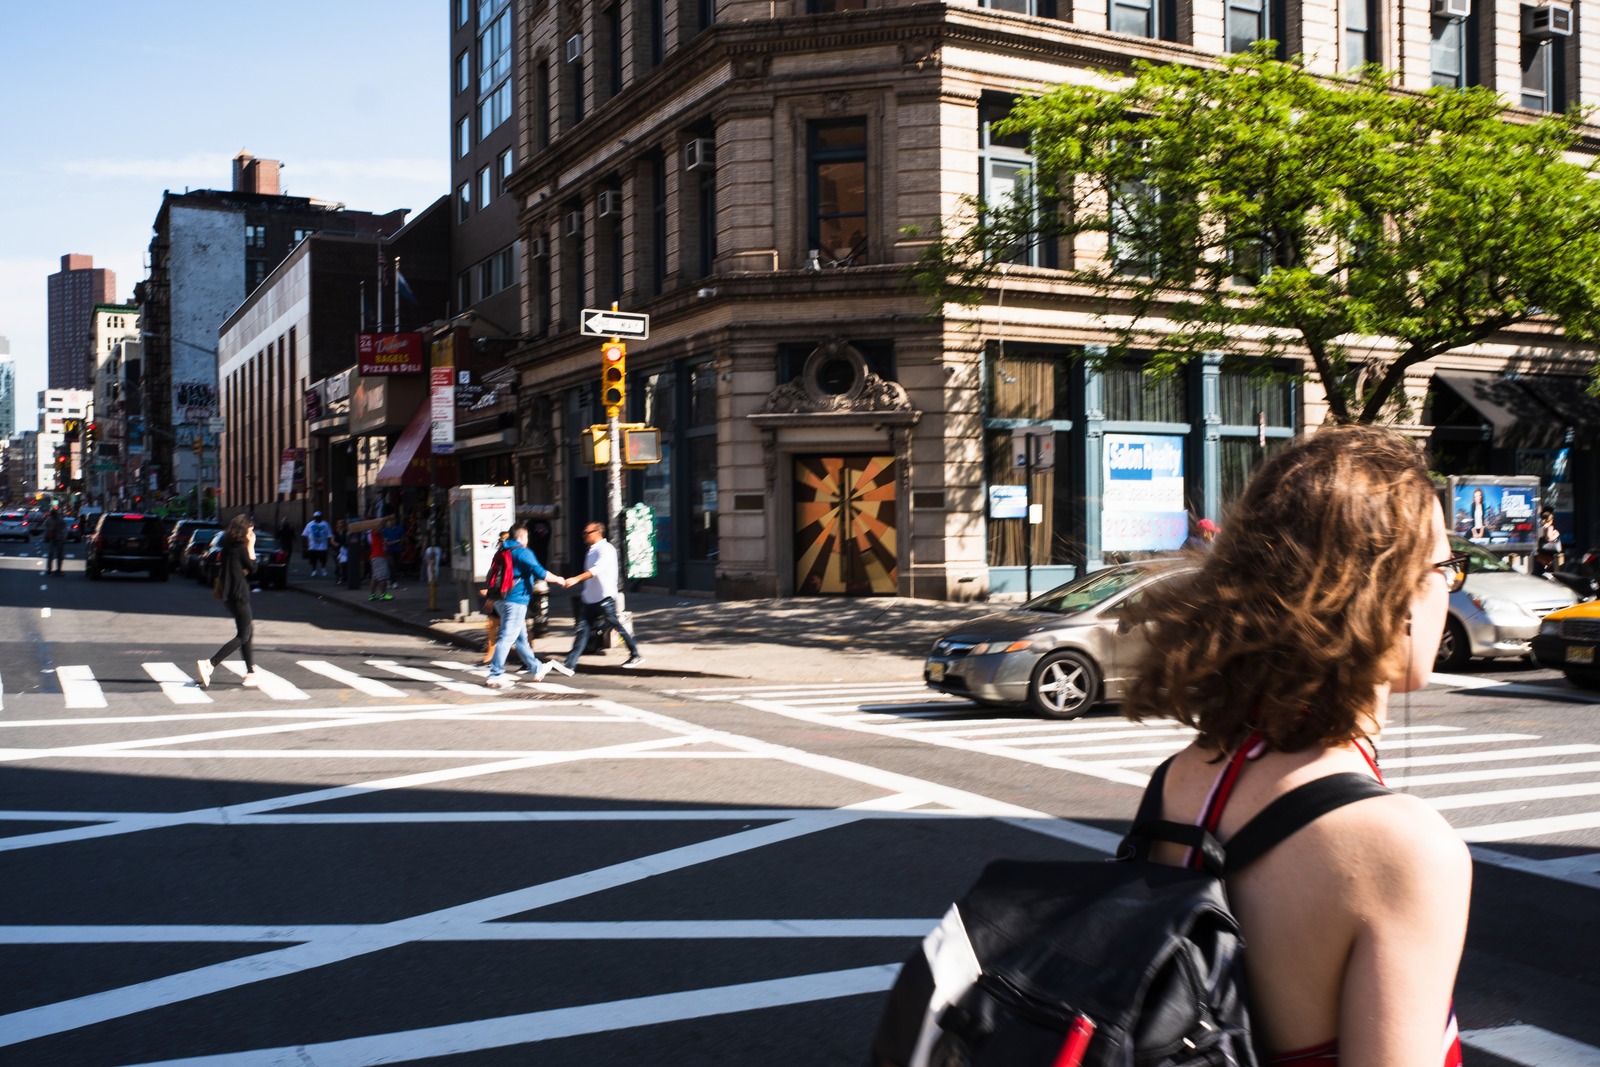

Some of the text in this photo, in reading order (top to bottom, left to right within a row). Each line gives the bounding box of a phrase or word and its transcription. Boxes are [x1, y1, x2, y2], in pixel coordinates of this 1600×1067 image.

[360, 339, 372, 348] 24
[375, 353, 410, 364] BAGELS
[362, 363, 422, 373] PIZZA & DELI
[1110, 442, 1181, 476] Salon Realty
